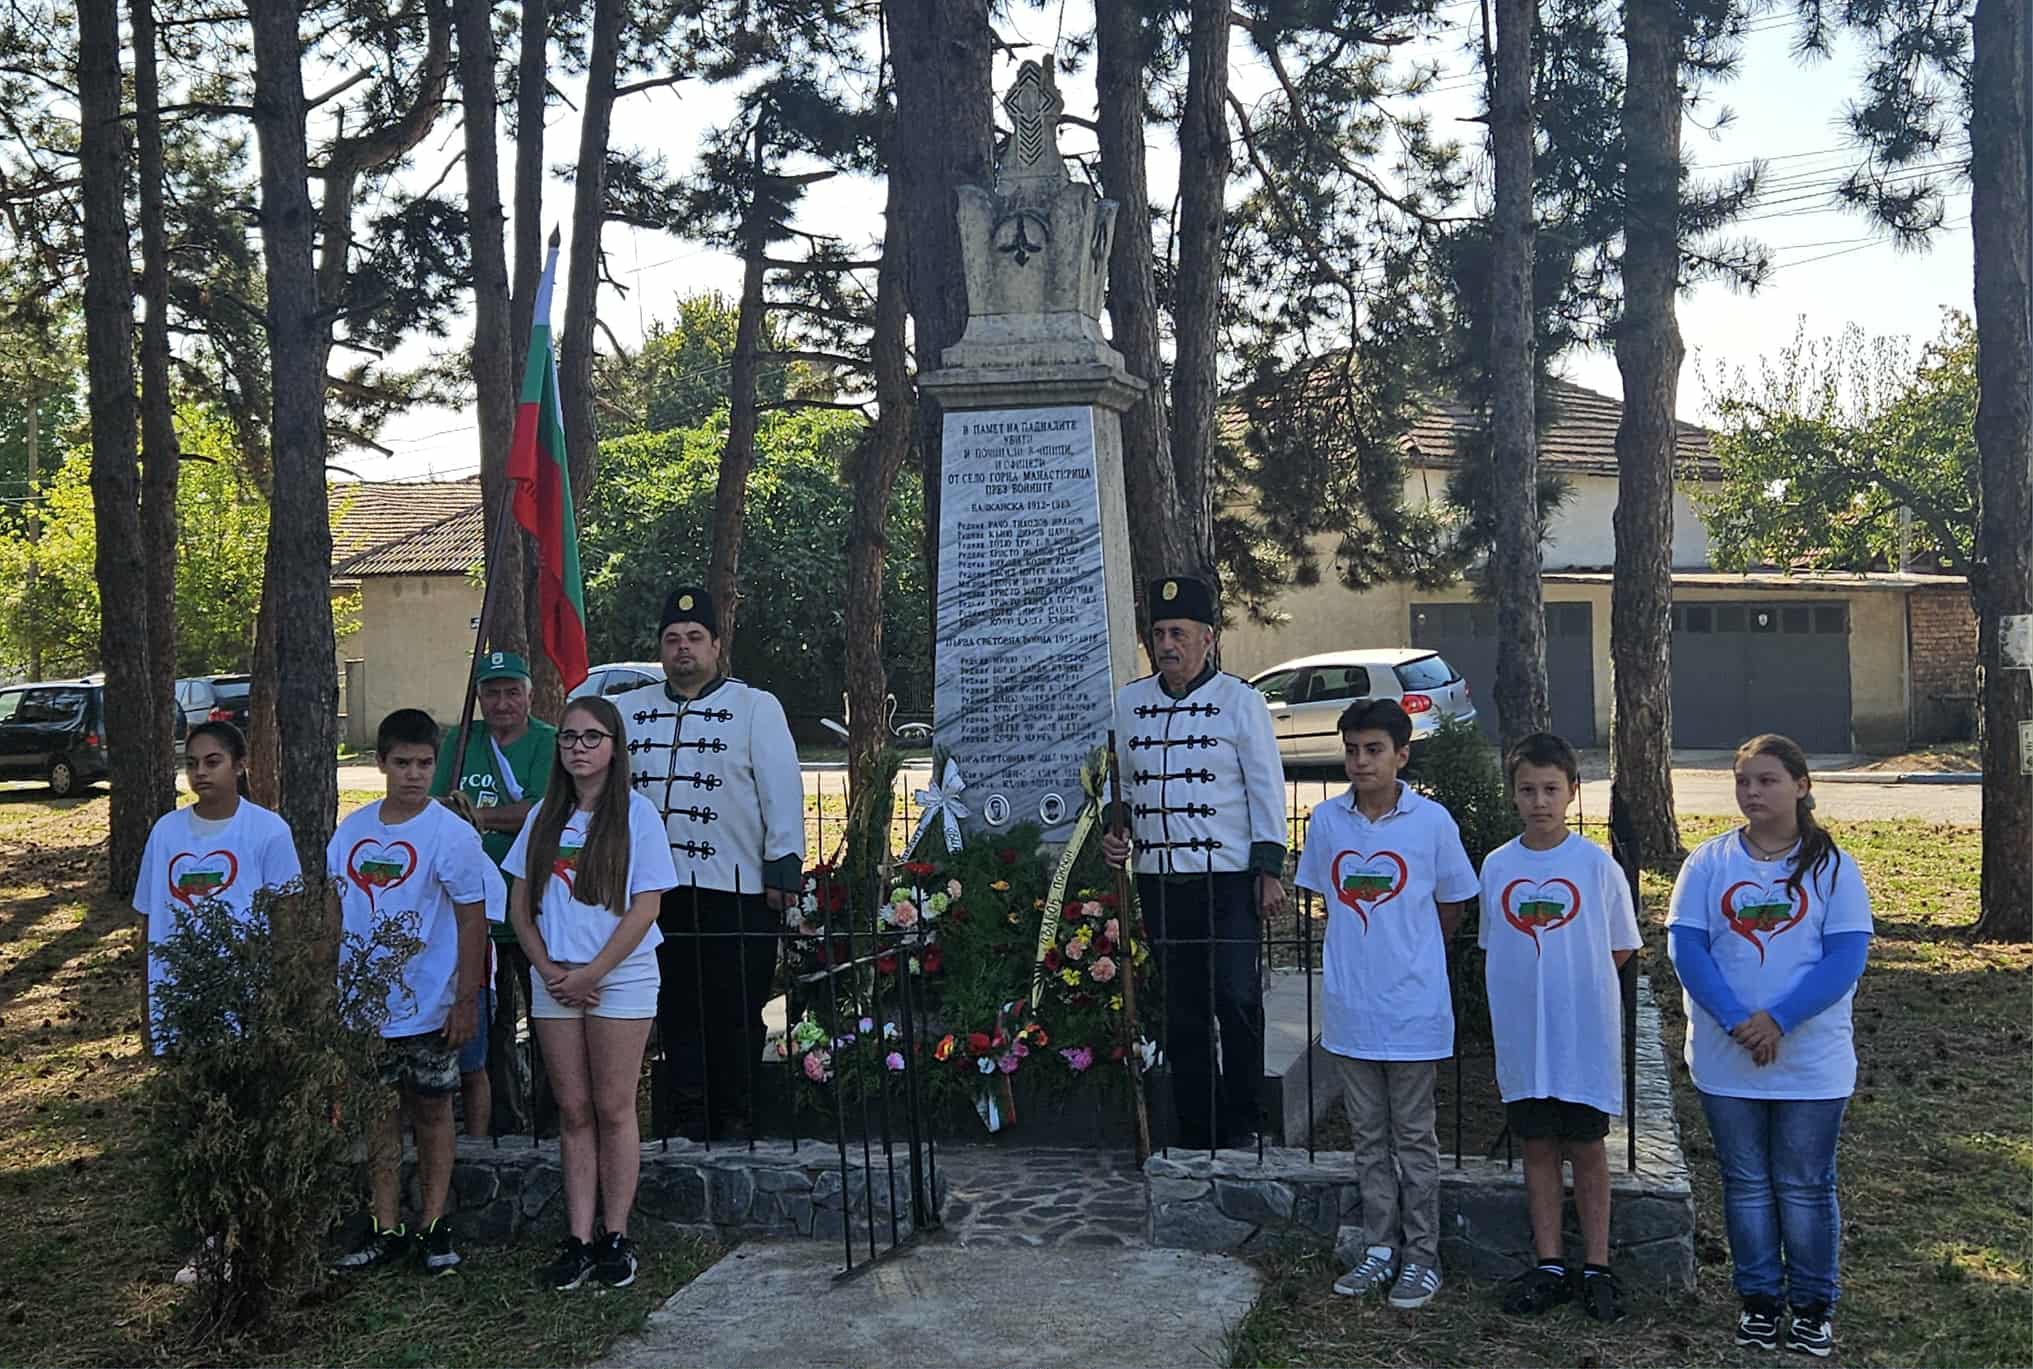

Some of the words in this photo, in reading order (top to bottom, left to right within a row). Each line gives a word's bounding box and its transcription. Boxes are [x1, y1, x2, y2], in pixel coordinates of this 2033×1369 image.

[973, 423, 1003, 435] ПАМЕТ
[1006, 422, 1019, 433] НА
[1021, 420, 1078, 433] ПАДНАЛИТЕ
[947, 474, 959, 485] ОТ
[961, 473, 985, 484] СЕЛО
[990, 471, 1018, 483] ГОРНА
[985, 484, 1008, 496] ПРЕЗ
